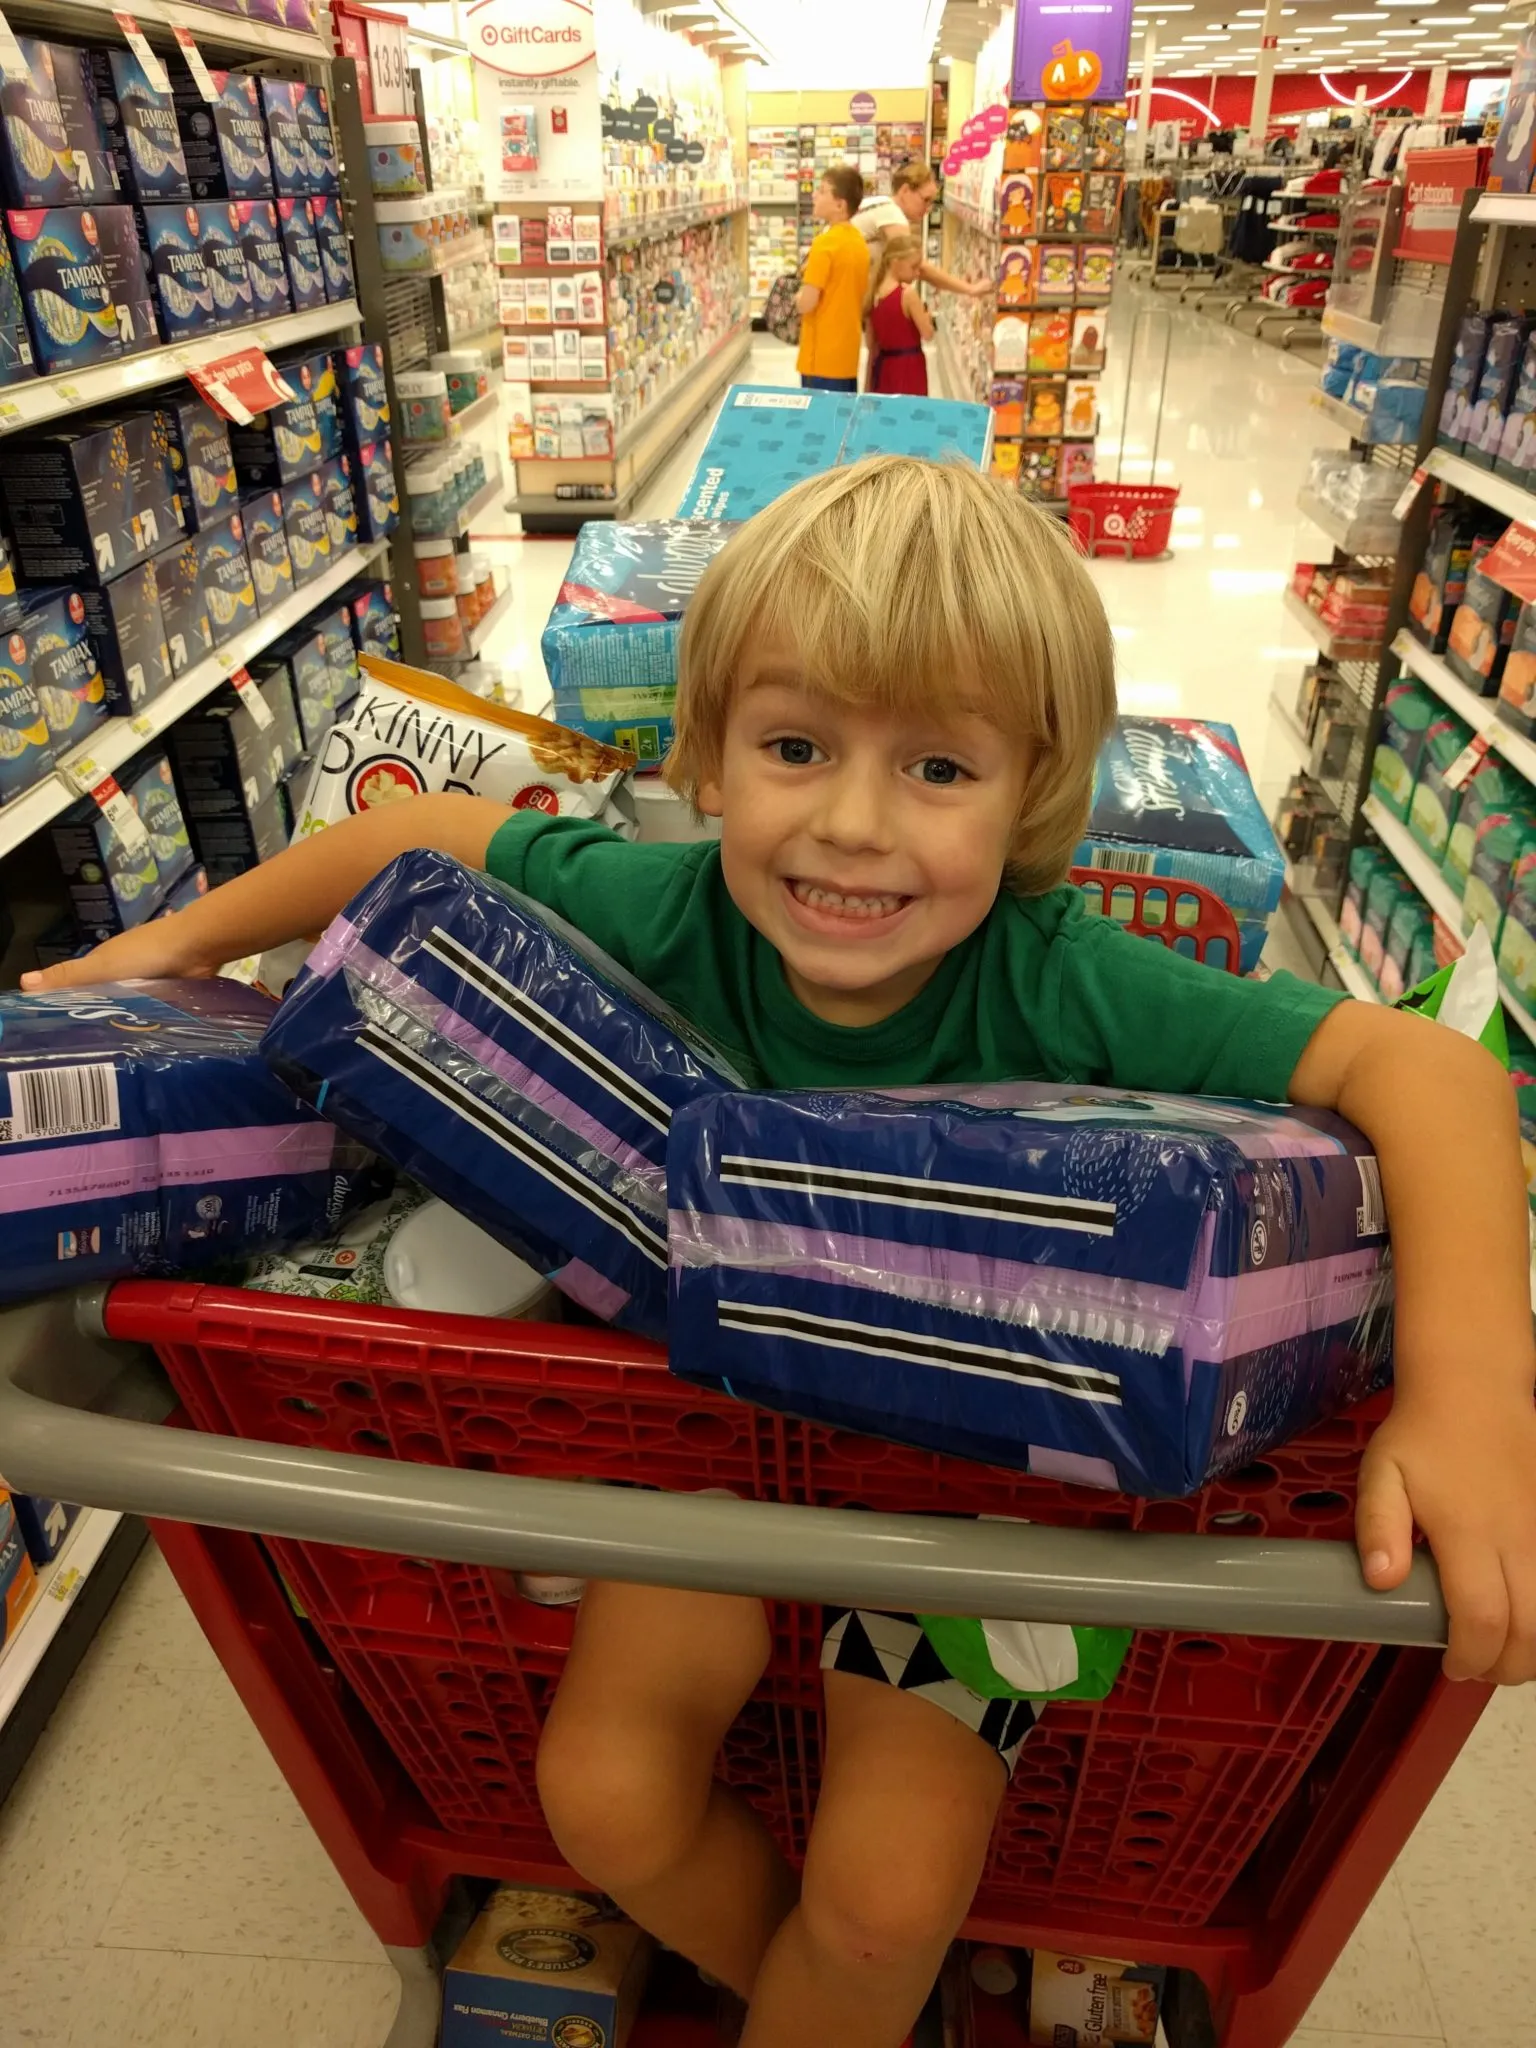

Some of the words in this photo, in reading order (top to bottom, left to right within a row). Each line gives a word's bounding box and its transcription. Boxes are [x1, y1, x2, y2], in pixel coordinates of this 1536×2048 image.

[500, 26, 582, 44] GiftCards
[167, 252, 206, 274] TAMPAX
[57, 264, 106, 290] TAMPAX
[50, 640, 94, 680] TAMPAX
[0, 683, 36, 718] AMPAX
[528, 788, 552, 811] 60
[1086, 1973, 1108, 1995] free
[452, 2003, 469, 2015] Flax
[469, 2006, 509, 2021] Cinnamon
[510, 2013, 549, 2027] Blueberry
[1084, 1995, 1106, 2033] Gluten
